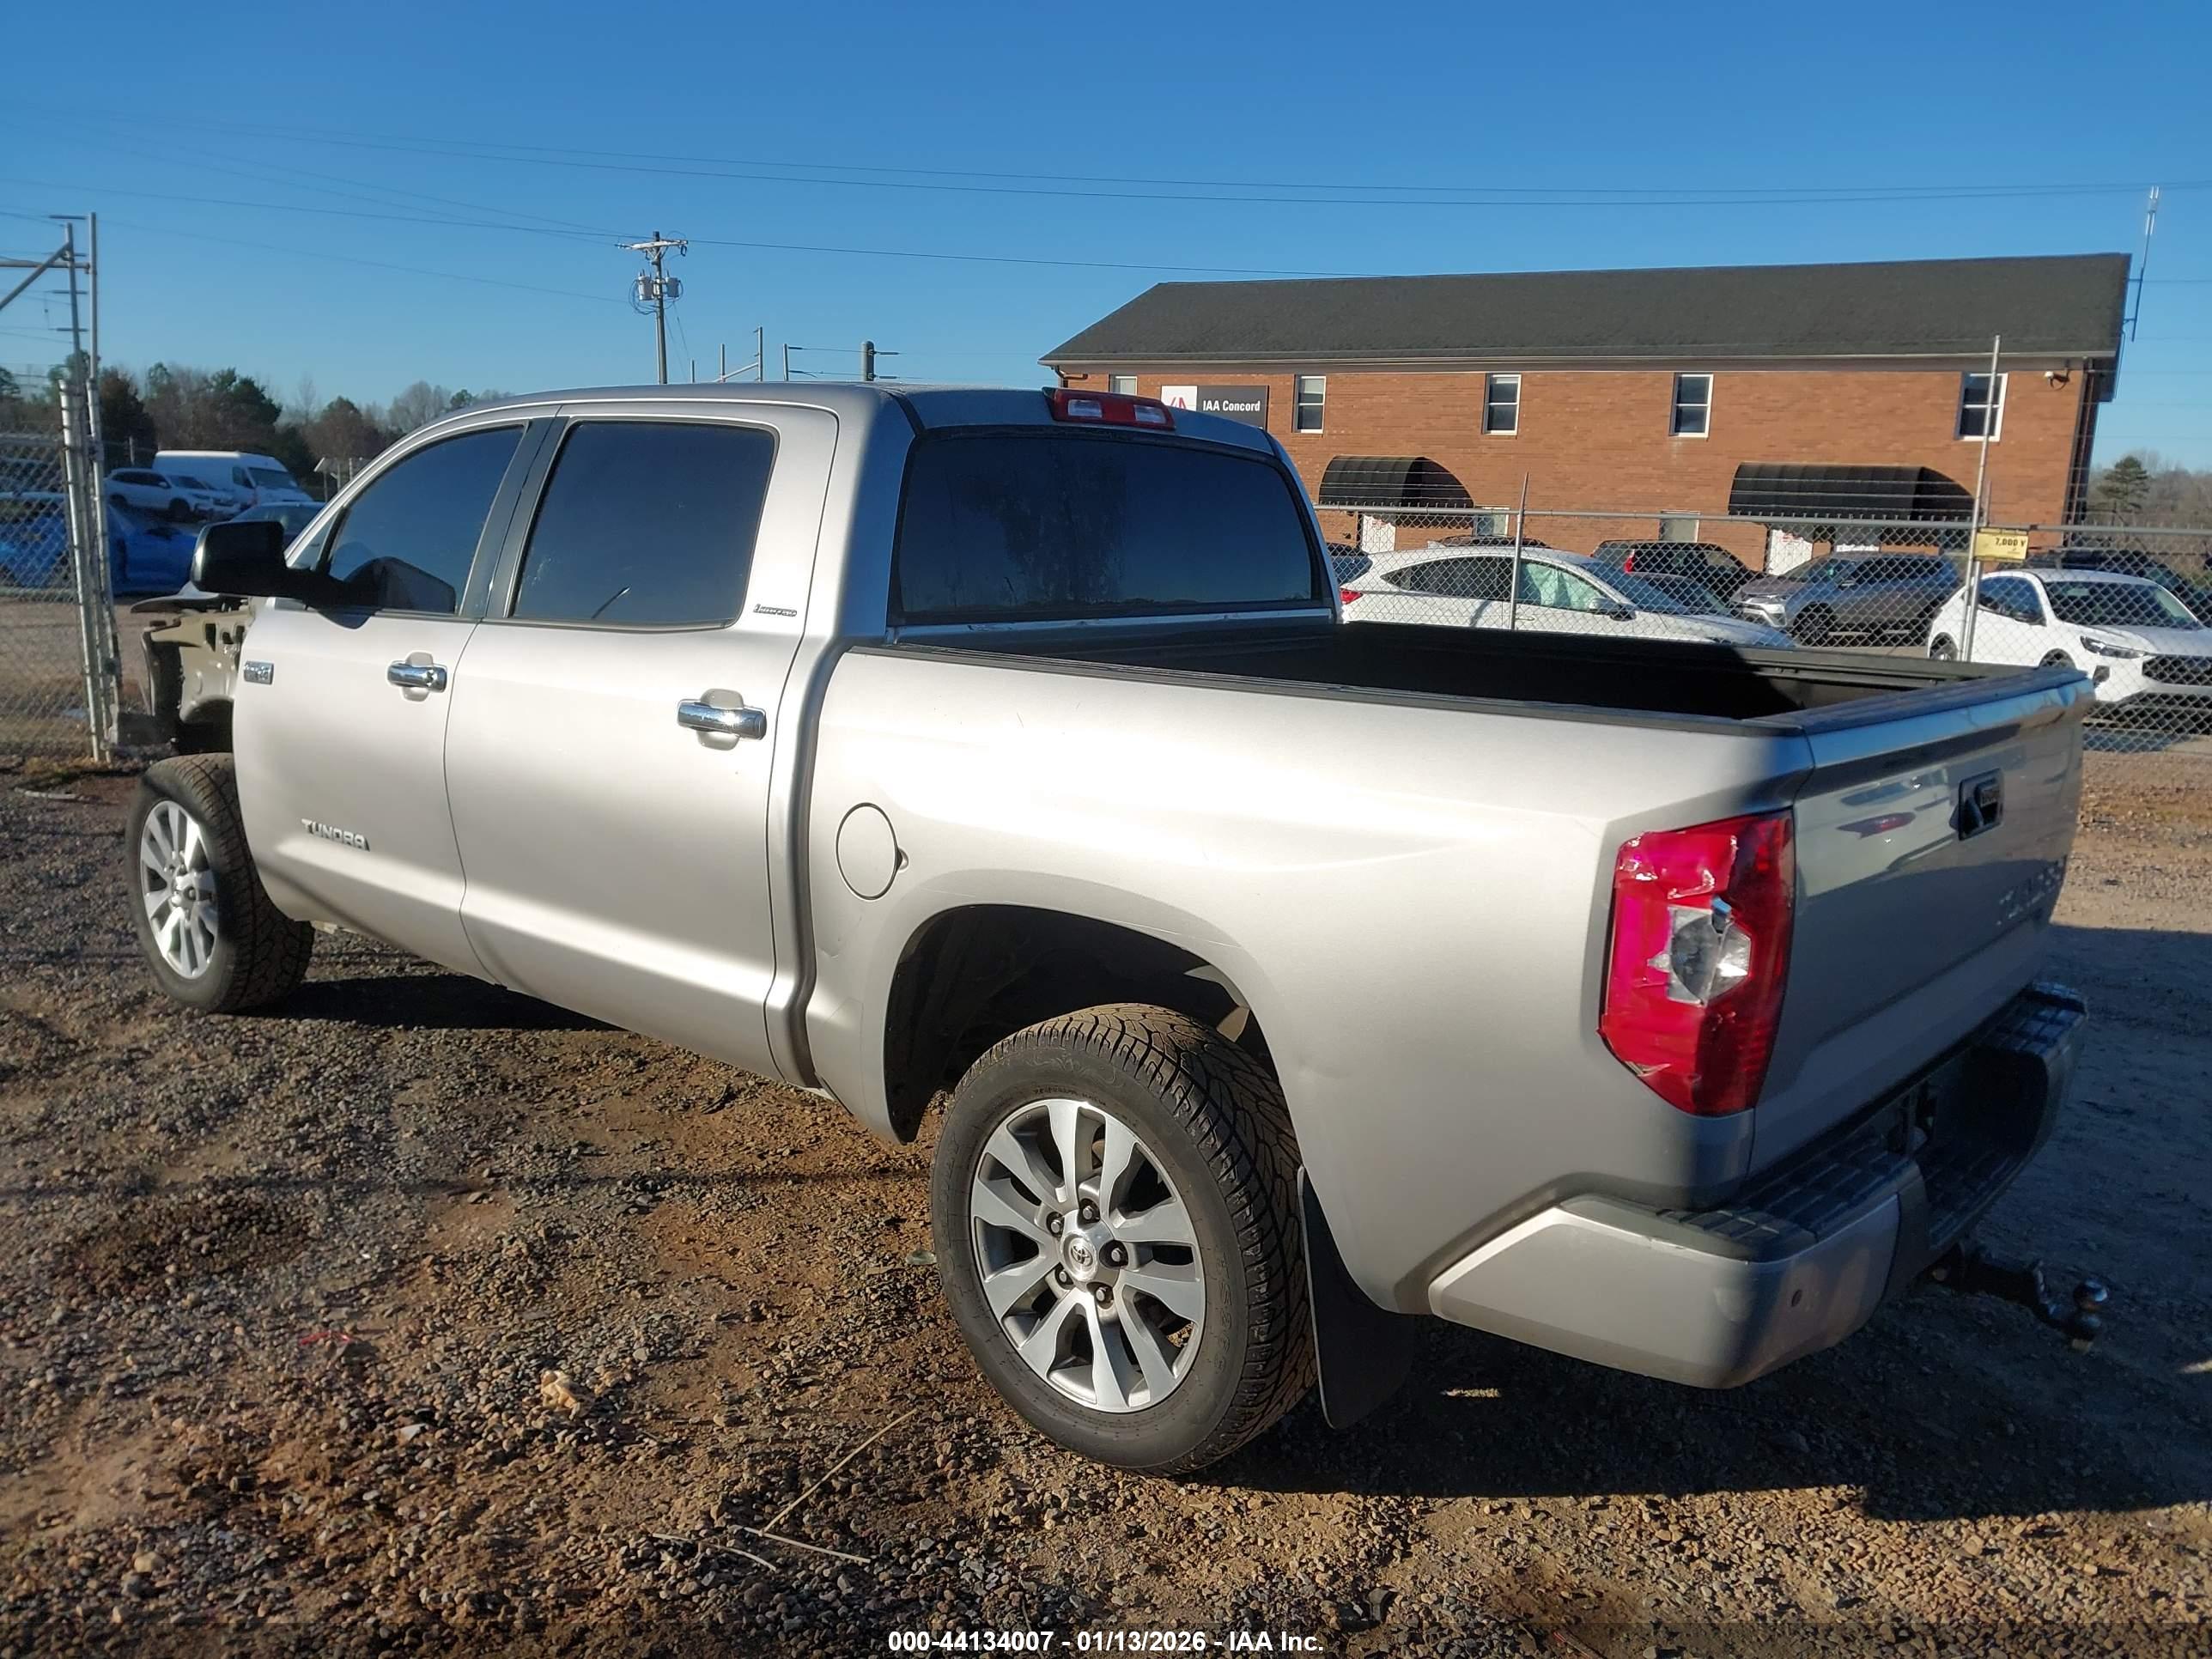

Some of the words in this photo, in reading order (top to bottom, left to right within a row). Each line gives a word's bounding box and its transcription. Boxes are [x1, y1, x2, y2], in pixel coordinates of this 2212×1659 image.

[1202, 400, 1220, 411] IAA
[1222, 399, 1261, 411] Concord
[1995, 538, 2018, 547] 7,000
[301, 817, 371, 852] TUNDRA
